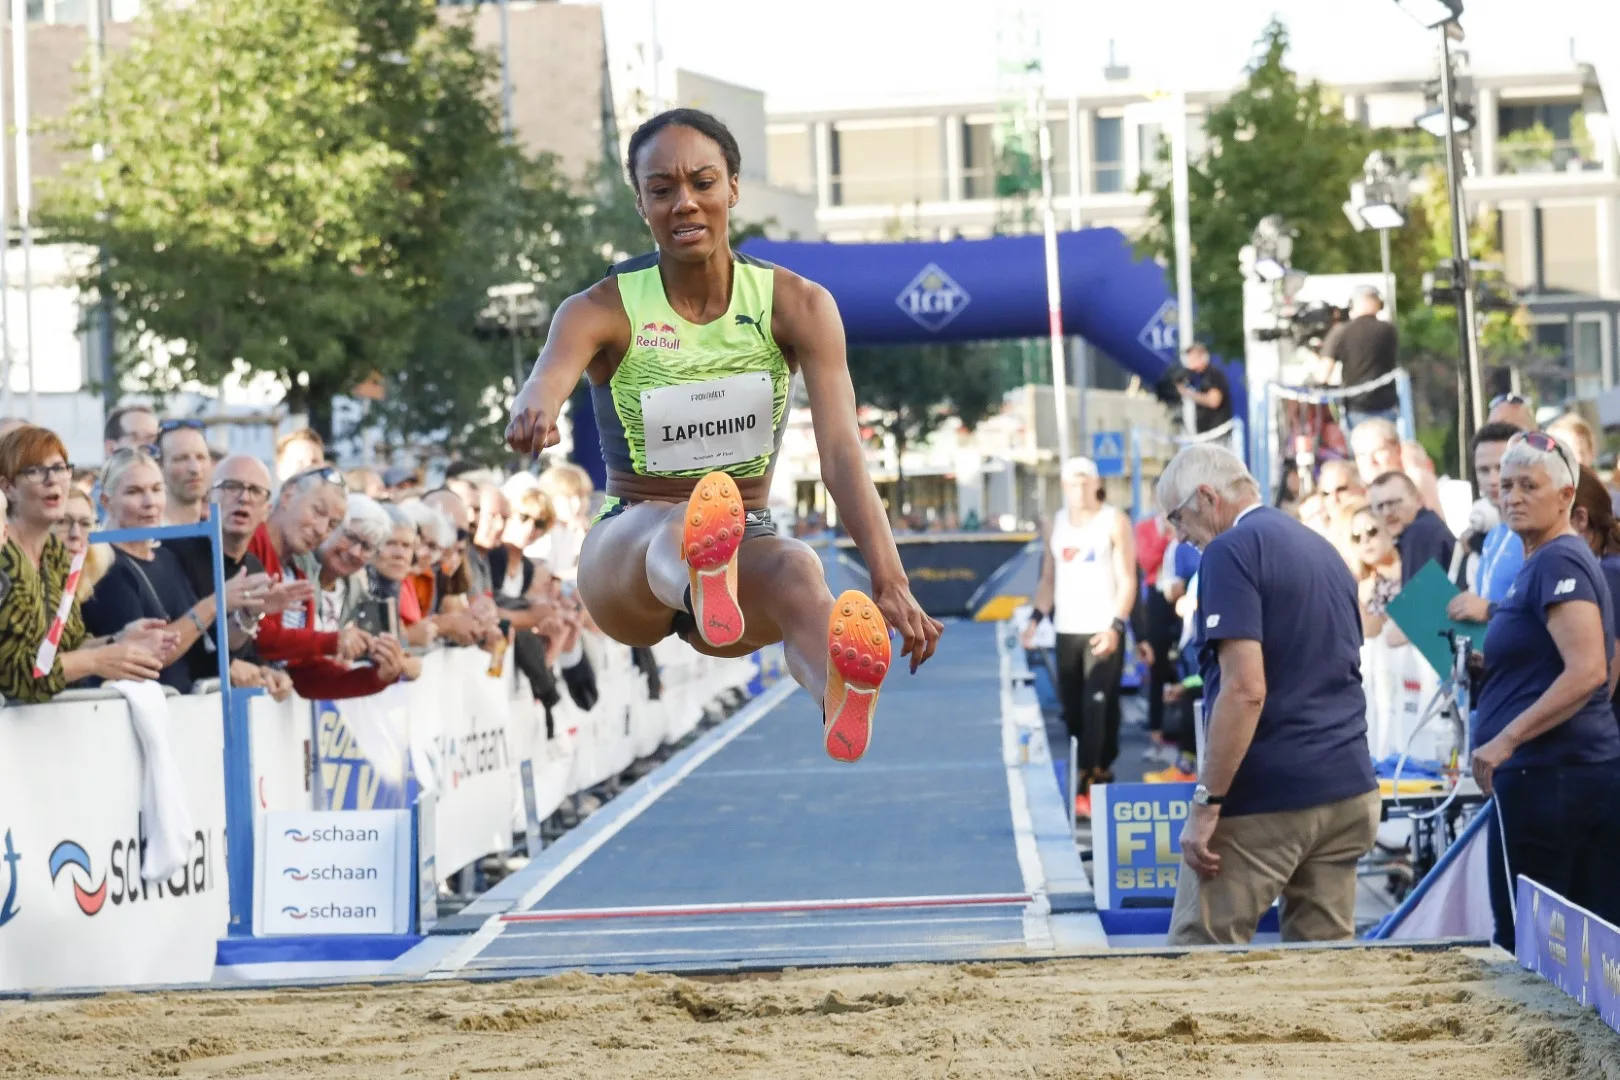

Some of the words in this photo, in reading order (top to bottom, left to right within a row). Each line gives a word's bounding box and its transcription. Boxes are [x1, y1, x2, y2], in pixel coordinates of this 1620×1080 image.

[636, 335, 657, 347] Red
[659, 338, 680, 350] Bull
[662, 413, 756, 442] IAPICHINO
[1113, 800, 1192, 821] GOLD
[312, 825, 379, 842] schaan
[1115, 821, 1184, 866] FL
[311, 864, 378, 880] schaan
[1115, 867, 1178, 889] SER
[309, 902, 377, 918] schaan
